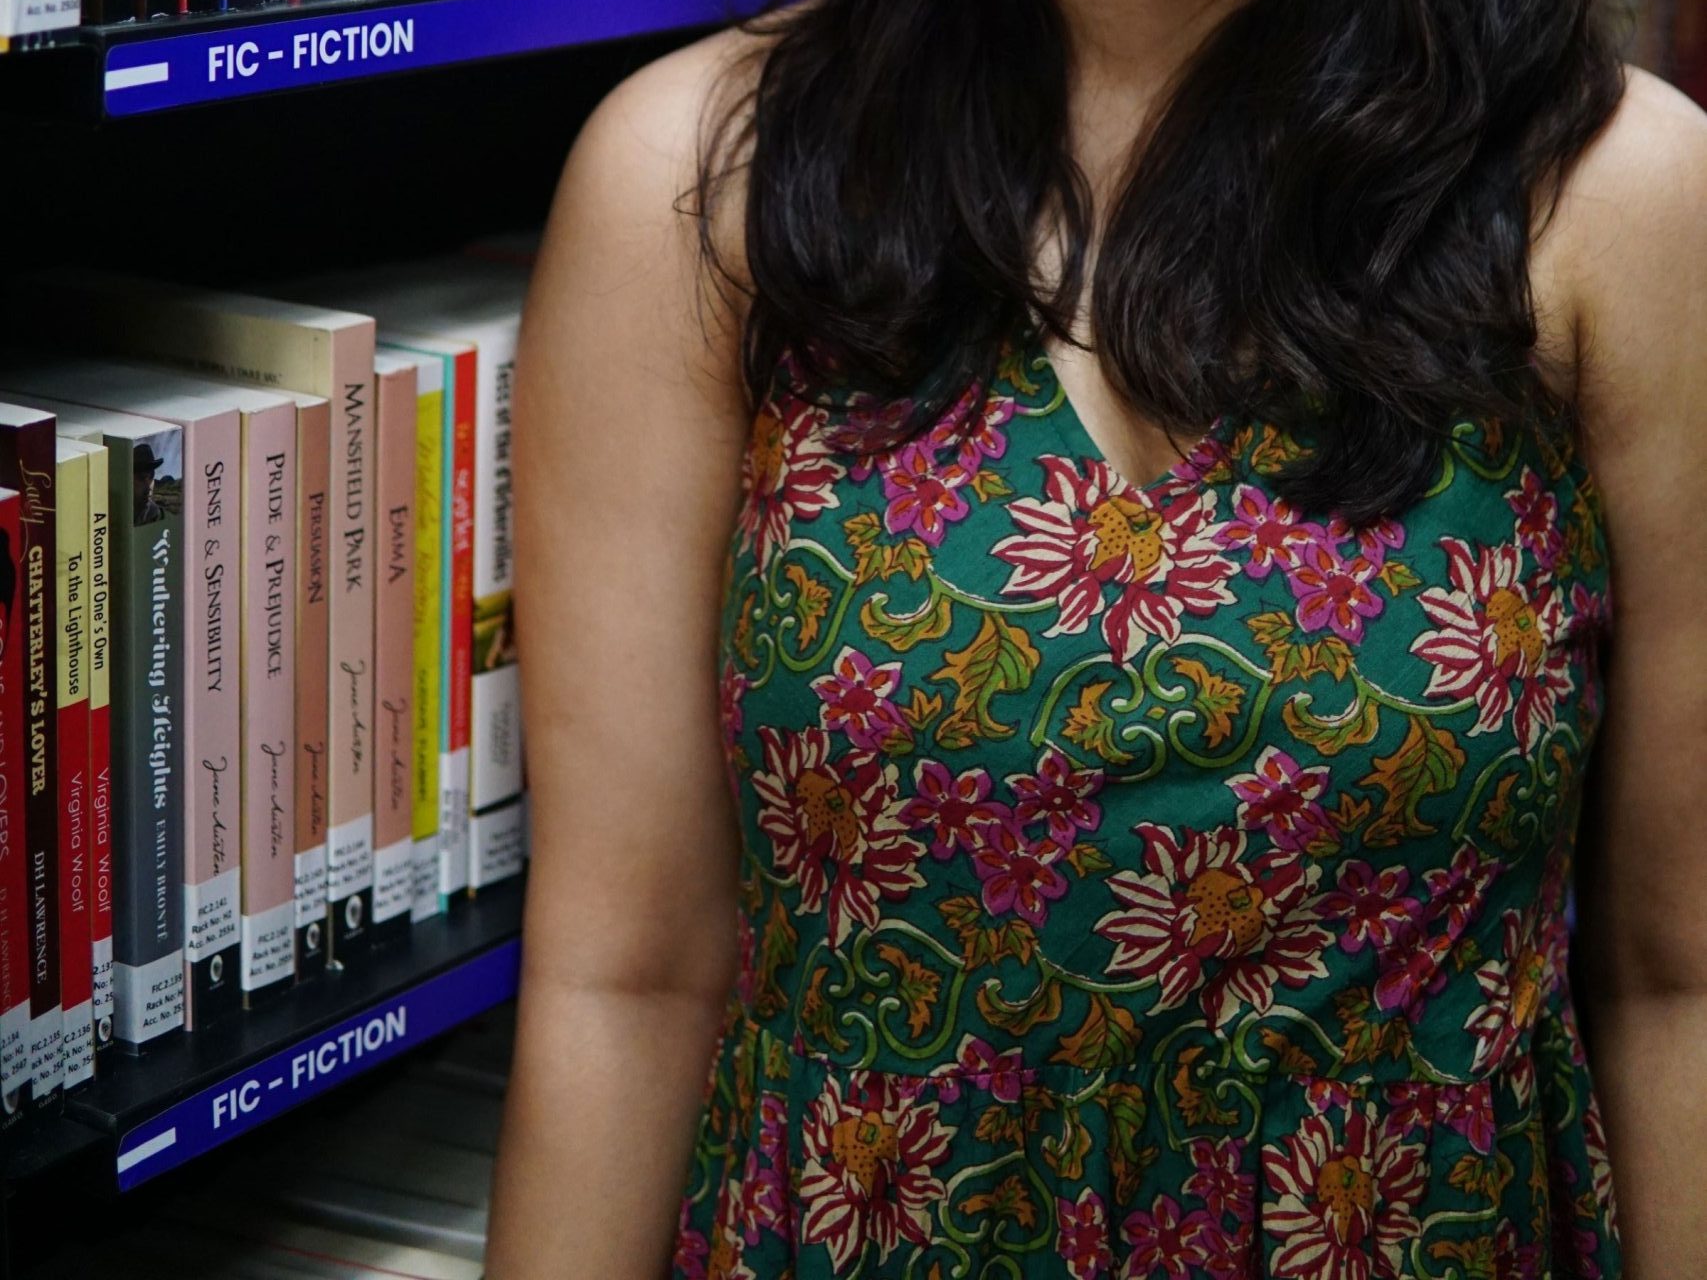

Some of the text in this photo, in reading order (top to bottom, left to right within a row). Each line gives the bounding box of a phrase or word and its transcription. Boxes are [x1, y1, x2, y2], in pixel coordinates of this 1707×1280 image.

[208, 41, 260, 82] FIC
[293, 19, 414, 69] FICTION
[308, 492, 324, 604] PERSUASION
[344, 383, 365, 594] MANSFIELD PARK
[388, 505, 408, 585] EMMA
[29, 545, 47, 717] CHATTERLEY'S
[65, 551, 82, 696] To the Lighthouse
[93, 513, 107, 671] A Room of One's Own
[204, 460, 224, 693] SENSE & SENSIBILITY
[264, 452, 286, 680] PRIDE & PREJUDICE
[148, 528, 172, 810] Wuthering Heights
[30, 720, 46, 796] LOVER
[202, 756, 228, 878] Jane Austen
[260, 740, 286, 860] Jane Austen
[68, 771, 85, 913] Virginia Woolf
[94, 767, 110, 913] Virginia Woolf
[156, 820, 167, 870] EMILY
[34, 851, 48, 984] DH LAWRENCE
[212, 1080, 260, 1129] FIC
[292, 1006, 406, 1088] FICTION
